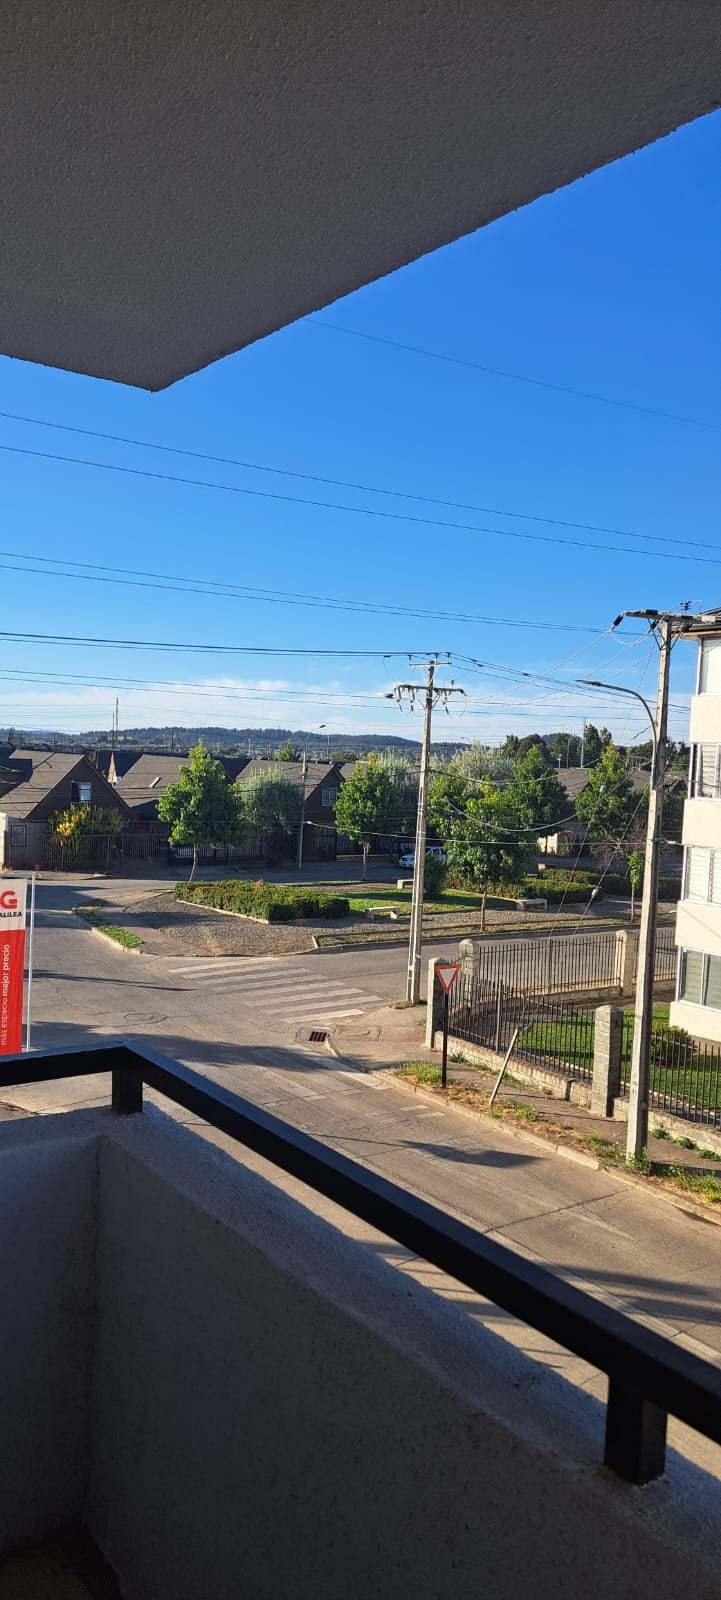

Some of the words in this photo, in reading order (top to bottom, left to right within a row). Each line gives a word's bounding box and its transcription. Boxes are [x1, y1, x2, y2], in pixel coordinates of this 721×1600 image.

[0, 890, 18, 910] G
[2, 944, 10, 970] precio
[1, 972, 10, 997] mejor
